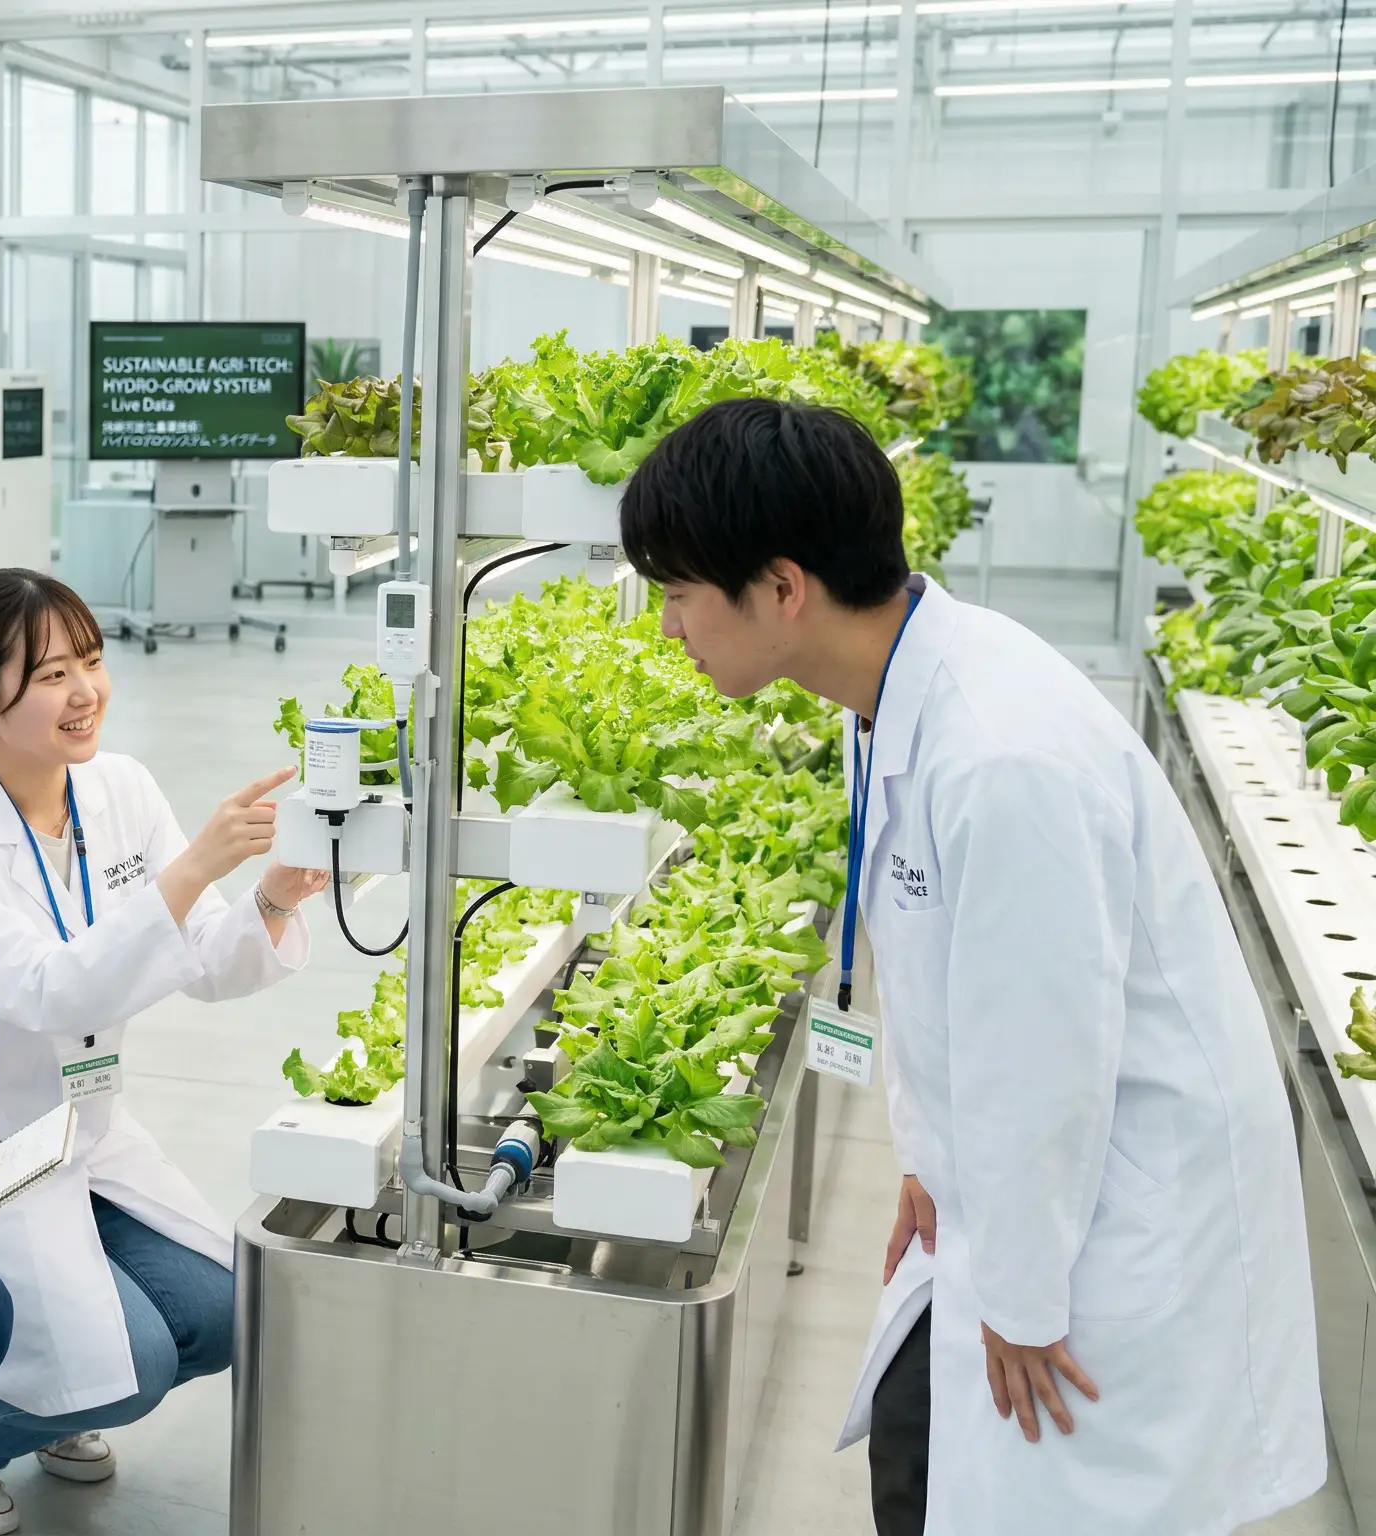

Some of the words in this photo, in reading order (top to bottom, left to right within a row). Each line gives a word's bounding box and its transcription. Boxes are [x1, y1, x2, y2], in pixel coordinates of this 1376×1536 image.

[102, 357, 205, 373] SUSTAINABLE
[207, 357, 293, 373] AGRI-TECH:
[103, 378, 211, 394] HYDRO-GROW
[213, 378, 272, 394] SYSTEM
[111, 397, 140, 412] Live
[142, 397, 175, 412] Data
